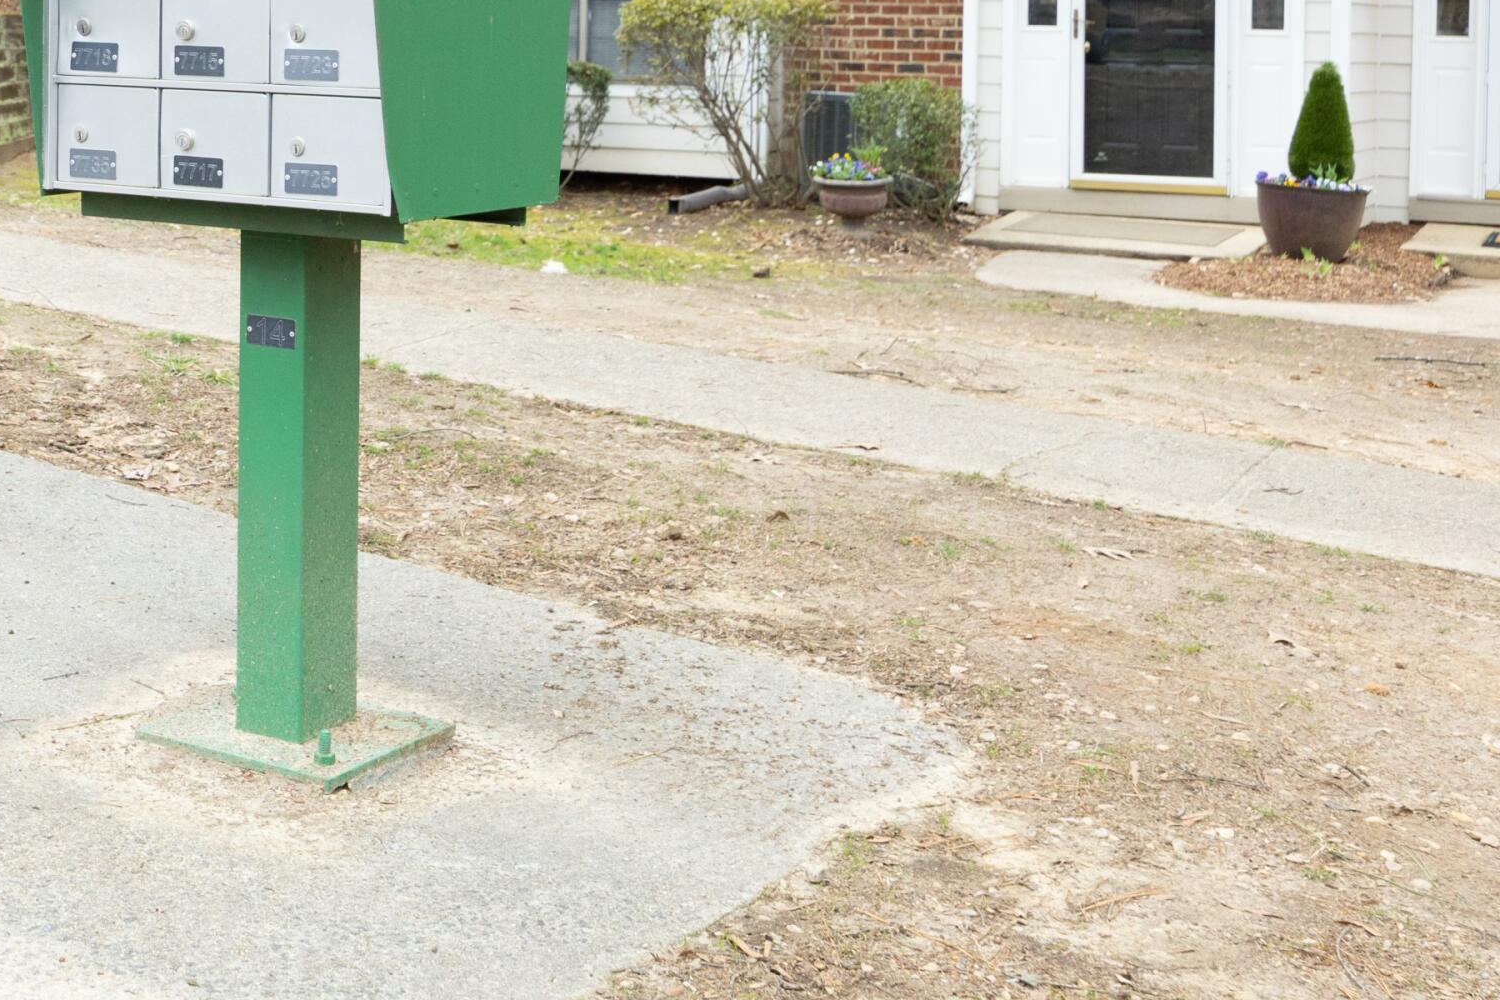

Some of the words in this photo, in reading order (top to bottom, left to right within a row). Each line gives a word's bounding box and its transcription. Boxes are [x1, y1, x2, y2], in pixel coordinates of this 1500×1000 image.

[177, 161, 218, 182] 7717
[289, 168, 332, 189] 7725
[256, 317, 286, 347] 14
